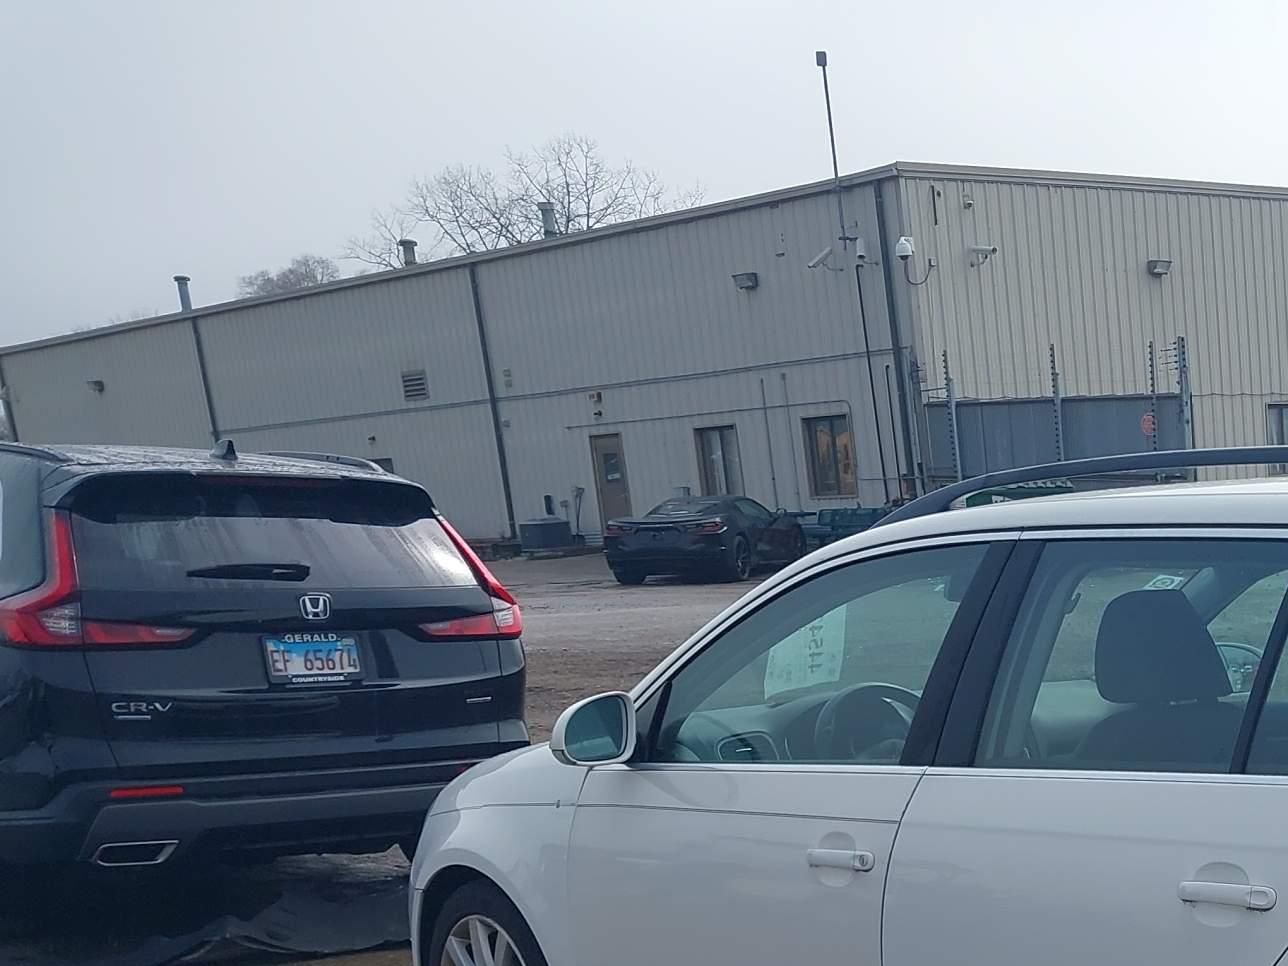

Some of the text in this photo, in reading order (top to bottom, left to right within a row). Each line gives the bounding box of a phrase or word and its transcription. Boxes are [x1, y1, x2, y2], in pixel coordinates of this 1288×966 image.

[284, 633, 337, 643] GERALD
[304, 647, 358, 671] 65674
[111, 702, 172, 713] CR-V
